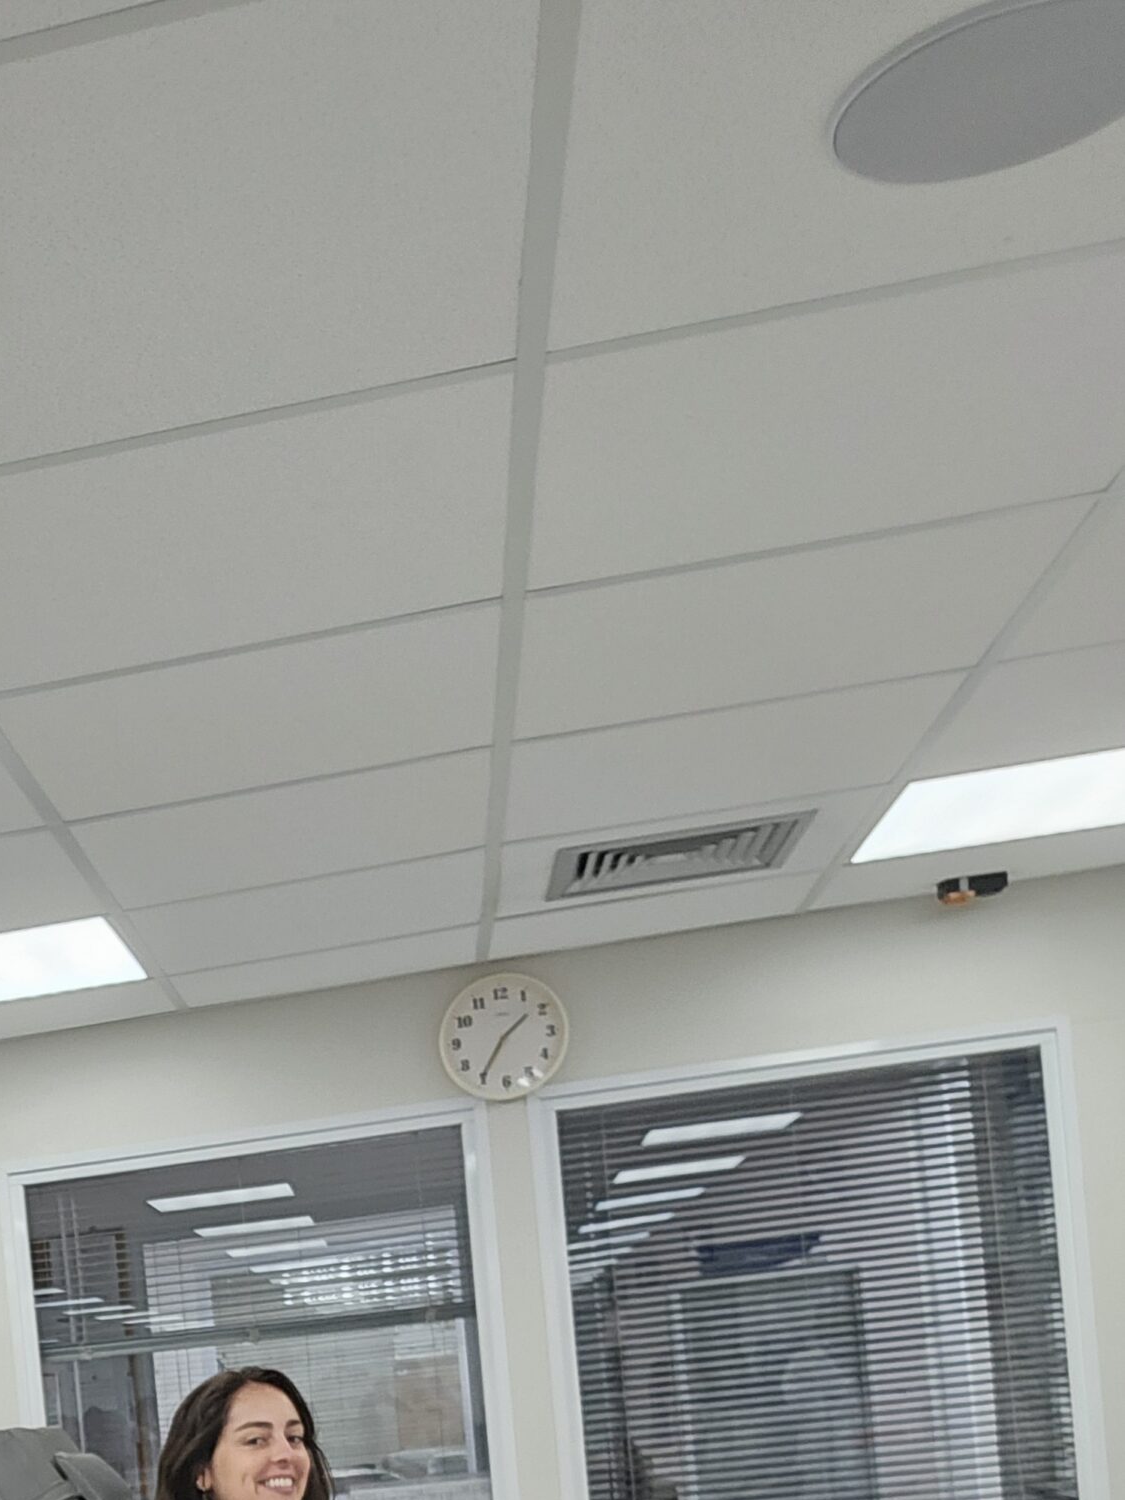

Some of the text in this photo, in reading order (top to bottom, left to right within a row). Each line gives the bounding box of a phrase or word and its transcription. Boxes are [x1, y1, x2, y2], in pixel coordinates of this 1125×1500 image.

[493, 987, 509, 1000] 12
[472, 997, 486, 1010] 11
[537, 1003, 548, 1016] 2
[456, 1015, 473, 1029] 10
[546, 1024, 556, 1037] 3
[451, 1038, 462, 1051] 9
[541, 1047, 549, 1060] 4
[460, 1059, 470, 1072] 8
[523, 1066, 535, 1079] 5
[502, 1075, 512, 1089] 6
